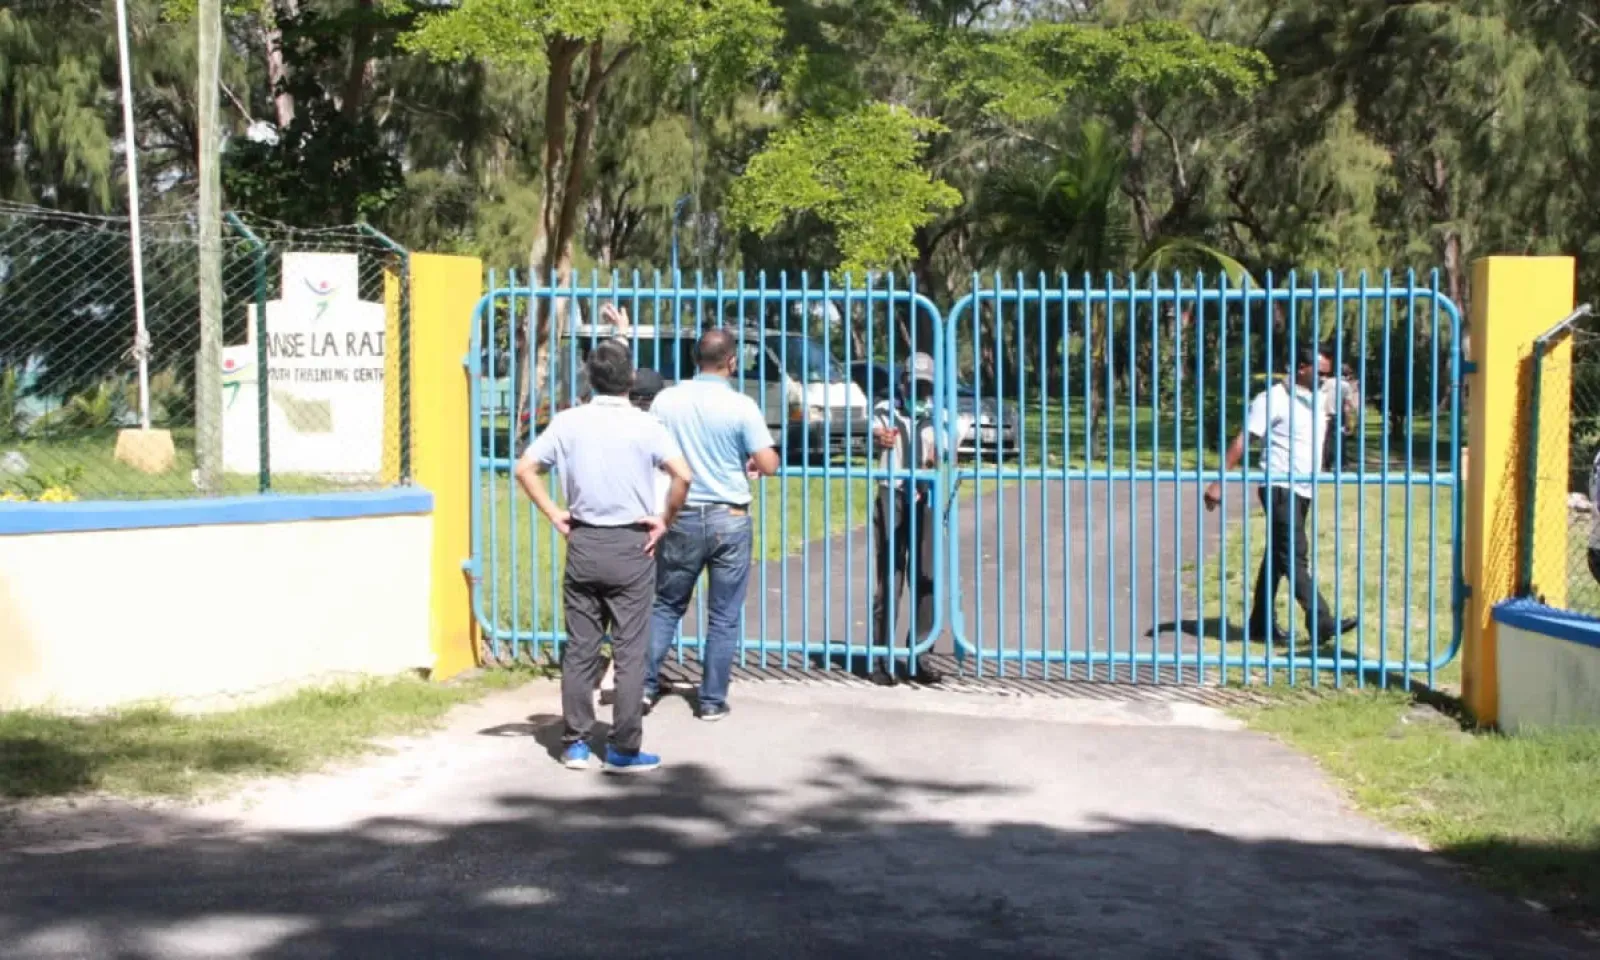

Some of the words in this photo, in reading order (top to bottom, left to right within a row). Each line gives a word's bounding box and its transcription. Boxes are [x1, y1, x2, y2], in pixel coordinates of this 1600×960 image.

[266, 331, 305, 358] ANSE
[310, 331, 339, 357] LA
[268, 367, 290, 381] OUTH
[294, 367, 348, 382] TRAINING
